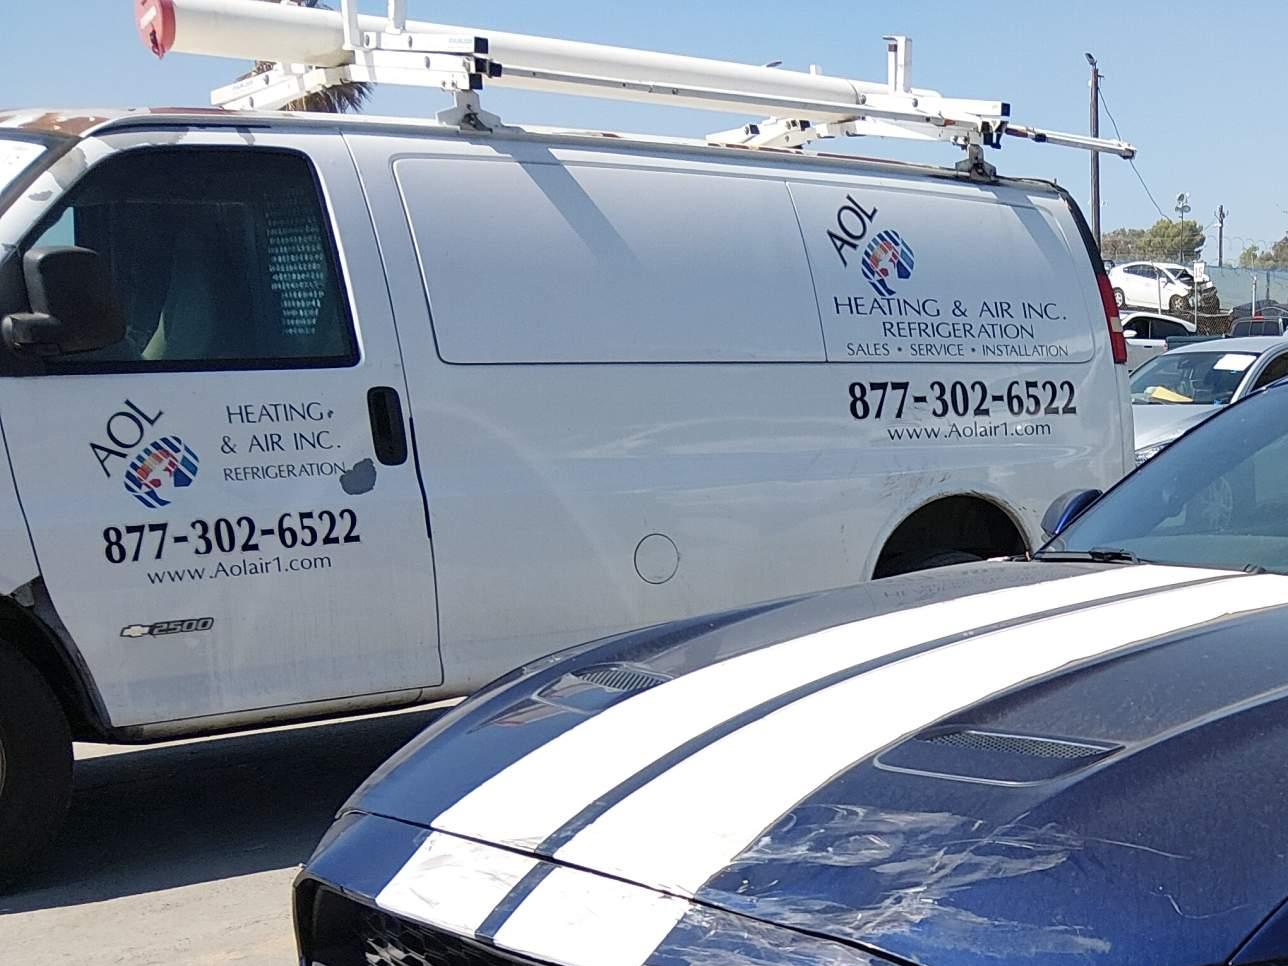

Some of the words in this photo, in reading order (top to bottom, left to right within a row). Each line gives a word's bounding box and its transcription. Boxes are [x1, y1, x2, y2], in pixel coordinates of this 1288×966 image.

[826, 194, 878, 268] AOL
[834, 296, 940, 318] HEATING
[951, 300, 968, 318] &
[979, 300, 1015, 319] AIR
[1022, 303, 1068, 321] INC.
[882, 321, 1035, 340] REFRIGERATION
[846, 343, 890, 357] SALES
[909, 343, 965, 357] SERVICE
[981, 344, 1069, 358] INSTALLATION
[849, 380, 1078, 421] 877-302-6522
[88, 398, 165, 478] AOL
[220, 436, 238, 455] &
[248, 432, 283, 454] AIR
[293, 430, 342, 451] INC.
[887, 421, 1051, 441] www.Aolair1.com
[223, 460, 347, 483] REFRIGERATION
[102, 508, 362, 565] 877-302-6522
[146, 554, 332, 585] www.Aolair1.com
[151, 617, 214, 635] 2500
